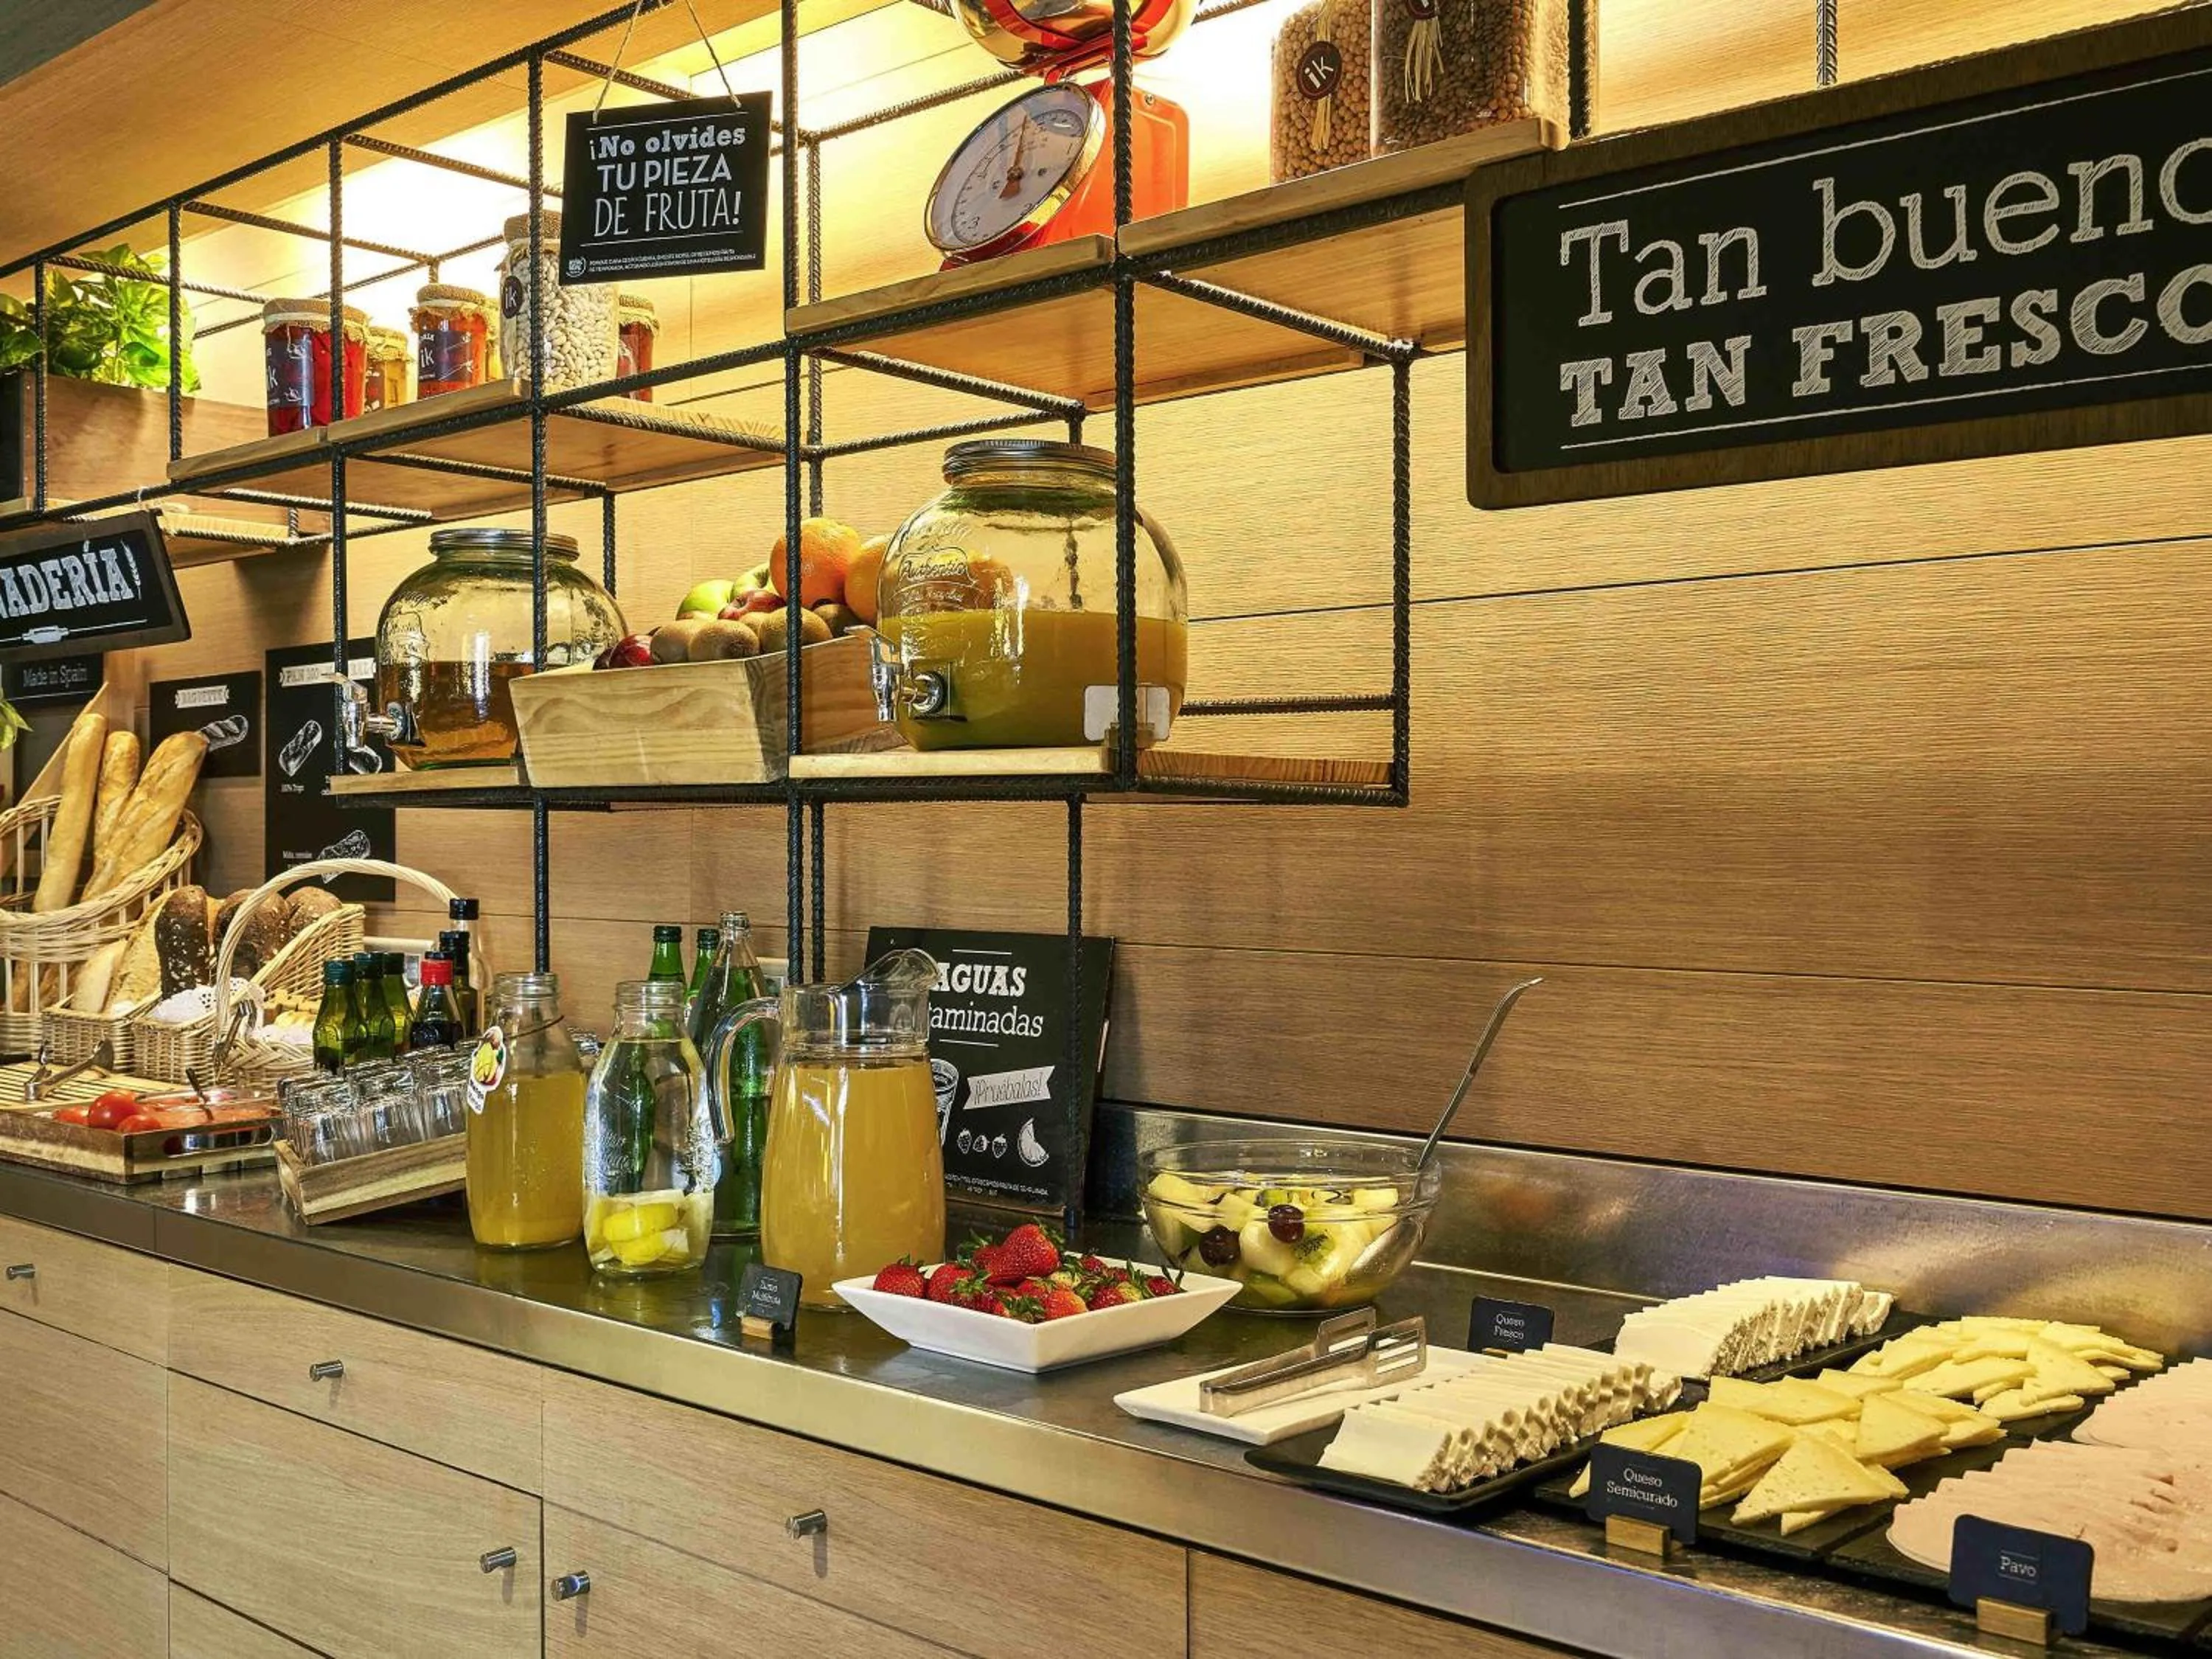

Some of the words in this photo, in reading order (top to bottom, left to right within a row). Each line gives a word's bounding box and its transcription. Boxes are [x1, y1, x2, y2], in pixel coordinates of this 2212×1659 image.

[1304, 56, 1334, 88] ik
[590, 134, 636, 160] ¡No
[645, 125, 746, 153] olvides
[597, 161, 636, 192] TU
[644, 153, 732, 189] PIEZA
[594, 196, 629, 237] DE
[645, 187, 742, 232] FRUTA!
[1559, 219, 1768, 327] Tan
[420, 347, 434, 368] ik
[1559, 336, 1752, 428] TAN
[931, 962, 1027, 997] AGUAS
[1607, 1480, 1678, 1508] Semicurado
[1623, 1468, 1663, 1488] Queso
[2000, 1555, 2037, 1577] Pavo
